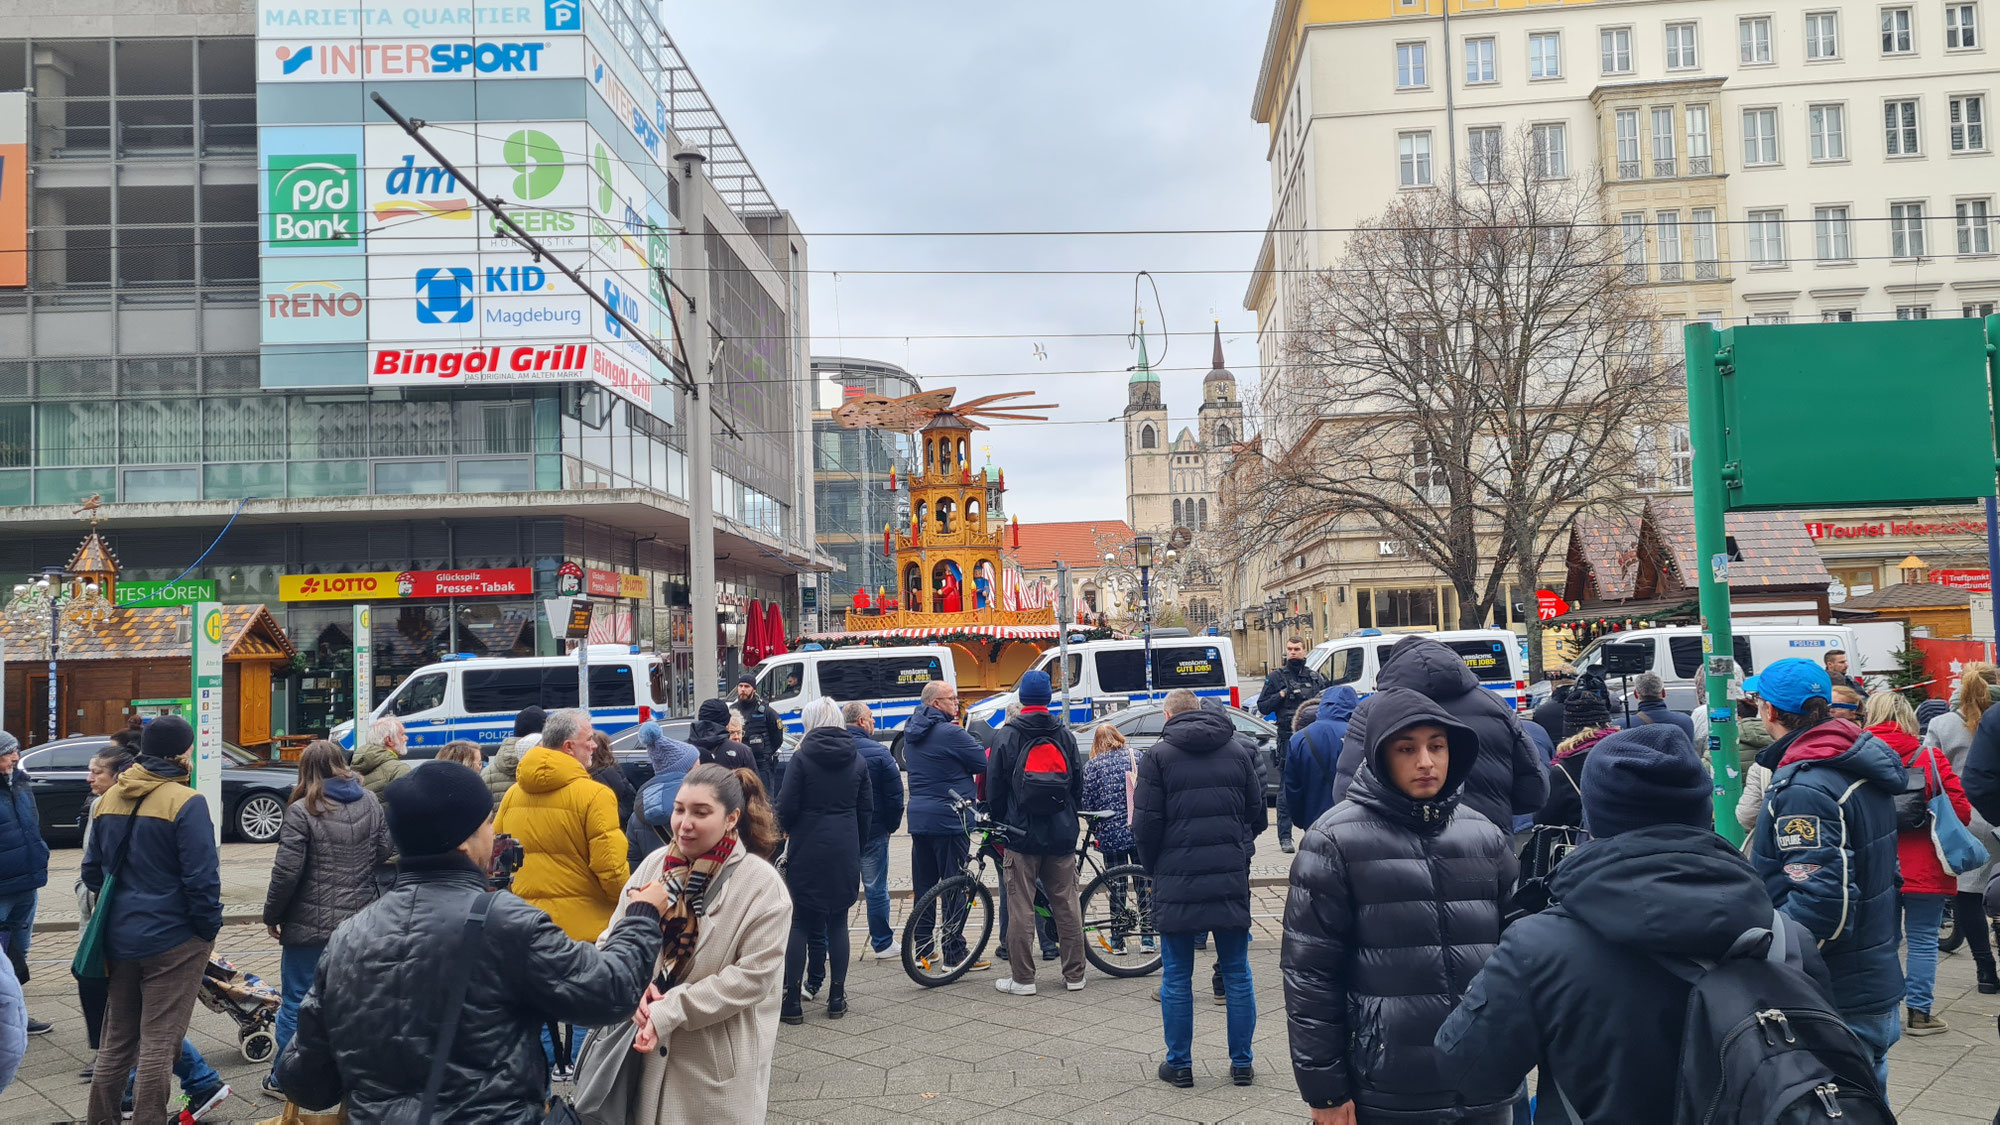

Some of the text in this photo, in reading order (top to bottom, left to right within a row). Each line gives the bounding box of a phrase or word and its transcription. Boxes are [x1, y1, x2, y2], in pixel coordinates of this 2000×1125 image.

[266, 7, 531, 28] MARIETTA QUARTIER
[320, 42, 544, 75] INTERSPORT
[386, 154, 456, 195] dm
[276, 214, 352, 240] Bank
[489, 211, 575, 232] GEERS
[490, 238, 574, 248] HÖRUSTIK
[267, 292, 363, 318] RENO
[486, 306, 581, 327] Magdeburg
[373, 345, 588, 378] Bingöl Grill
[531, 371, 556, 379] ALTEN
[557, 370, 583, 378] MARKT
[1823, 522, 1886, 538] Tourist
[323, 577, 378, 592] LOTTO
[436, 572, 481, 582] Glückspilz
[1950, 574, 1989, 583] Treffpunkt
[151, 583, 211, 600] HÖREN
[435, 581, 516, 593] Presse Tabak
[1540, 608, 1557, 620] 79
[1463, 659, 1478, 667] UTE
[478, 730, 515, 740] POLIZE
